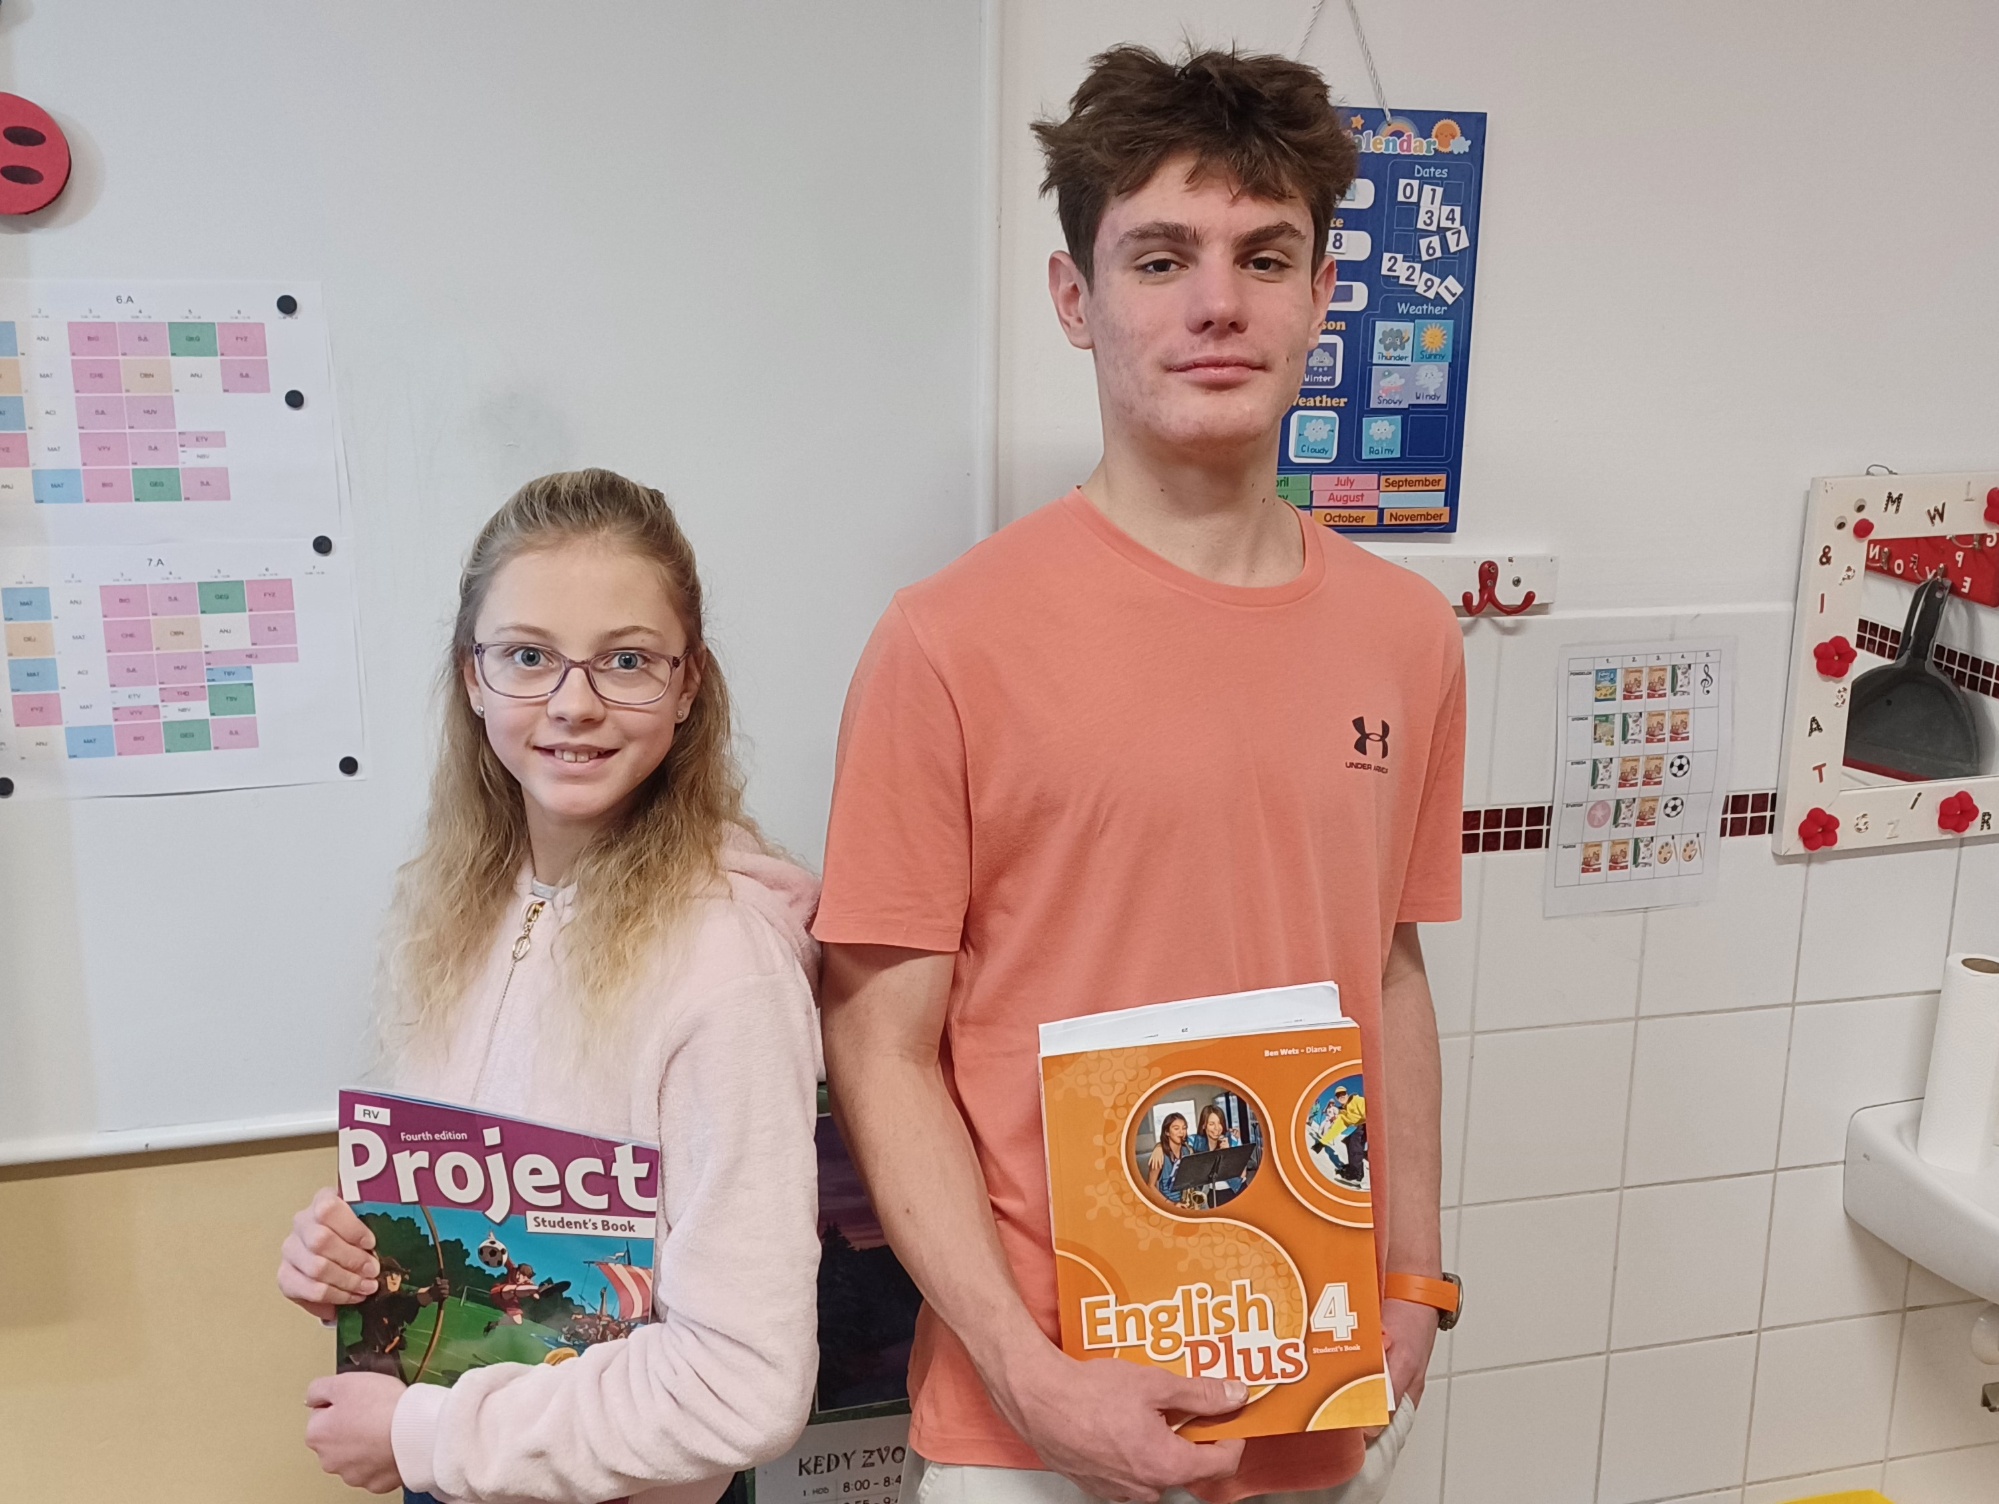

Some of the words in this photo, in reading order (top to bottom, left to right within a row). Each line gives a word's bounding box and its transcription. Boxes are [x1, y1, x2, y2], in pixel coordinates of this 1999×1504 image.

[1352, 130, 1438, 156] alendar
[1414, 165, 1448, 178] Dates
[1402, 182, 1414, 200] 0
[1430, 188, 1437, 205] 1
[1422, 209, 1434, 227] 3
[1445, 208, 1456, 225] 4
[1332, 232, 1343, 250] 8
[1450, 230, 1462, 248] 7
[1425, 240, 1436, 257] 6
[1387, 255, 1398, 273] 2
[1405, 265, 1416, 282] 2
[115, 294, 135, 305] 6.A
[1397, 302, 1448, 315] Weather
[1377, 352, 1409, 362] Thunder
[1420, 351, 1446, 361] Sunny
[1304, 373, 1332, 383] Winter
[1377, 396, 1403, 406] Snowy
[1415, 392, 1441, 401] Windy
[1300, 445, 1330, 456] Cloudy
[1368, 446, 1395, 456] Rainy
[1334, 477, 1355, 489] July
[1384, 477, 1442, 490] September
[1328, 492, 1365, 504] August
[1883, 491, 1903, 514] M
[1324, 512, 1366, 524] October
[1389, 511, 1444, 523] November
[1925, 502, 1946, 527] W
[147, 557, 165, 567] 7.A
[1819, 545, 1832, 566] &
[1808, 716, 1823, 737] A
[1345, 761, 1372, 770] UNDER
[1812, 763, 1827, 783] T
[1980, 811, 1992, 831] R
[1264, 1049, 1279, 1057] Ben
[1305, 1045, 1327, 1054] Diana
[1328, 1044, 1342, 1053] Pye
[362, 1108, 380, 1120] RV
[400, 1131, 433, 1142] Fourth
[433, 1130, 468, 1141] edition
[339, 1126, 658, 1224] Project
[533, 1216, 598, 1231] Student's
[601, 1218, 636, 1233] Book
[1082, 1282, 1271, 1357] English
[1309, 1281, 1358, 1341] 4
[1312, 1345, 1343, 1354] Student's
[1344, 1343, 1361, 1352] Book
[1184, 1335, 1303, 1382] Plus
[798, 1449, 857, 1476] KEDY
[861, 1445, 906, 1468] ZVO
[843, 1478, 870, 1493] 8:00
[883, 1474, 902, 1488] 8:4
